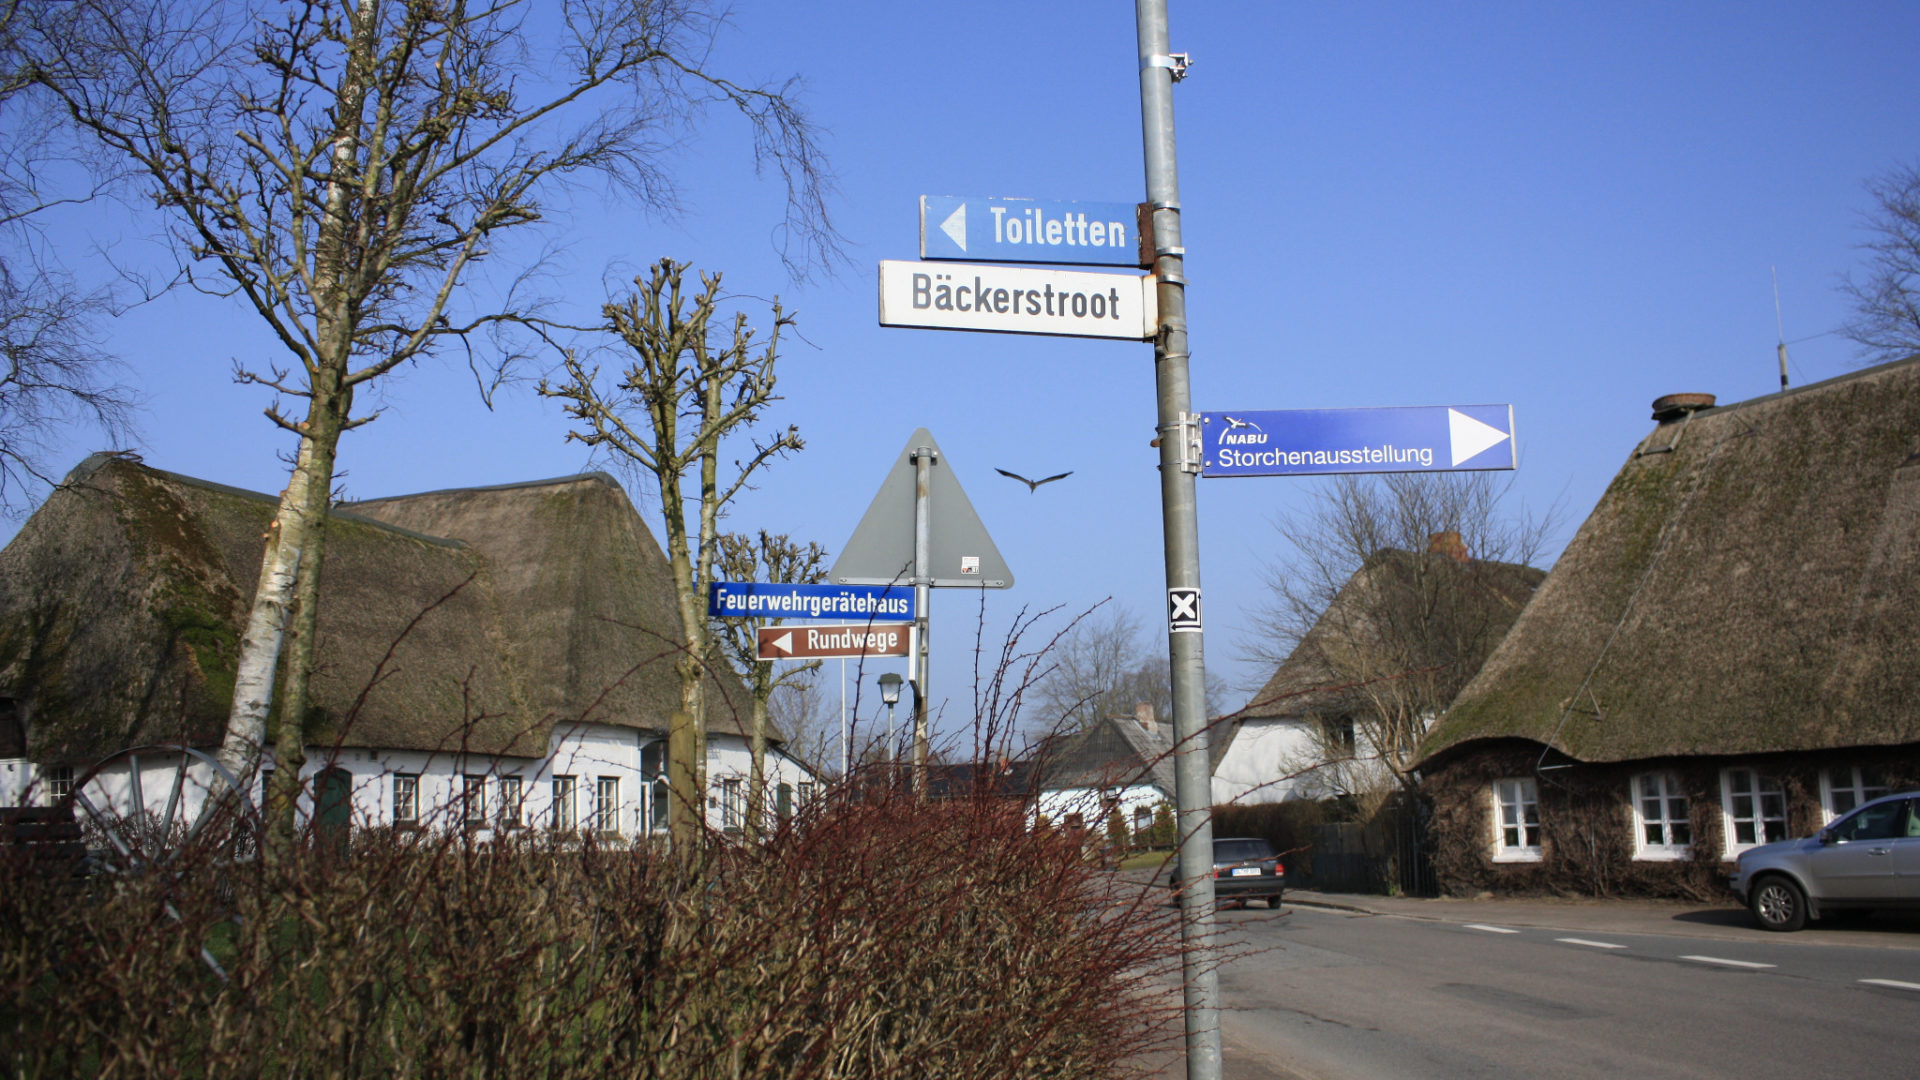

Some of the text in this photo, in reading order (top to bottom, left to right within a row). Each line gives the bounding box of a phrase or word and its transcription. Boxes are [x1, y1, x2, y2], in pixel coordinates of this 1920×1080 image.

[990, 206, 1126, 248] Toiletten
[912, 273, 1120, 320] Bäckerstroot
[1226, 433, 1268, 445] NABU
[1218, 445, 1433, 467] Storchenausstellung
[716, 589, 909, 617] Feuerwehrgerätehaus
[807, 629, 898, 652] Rundwege
